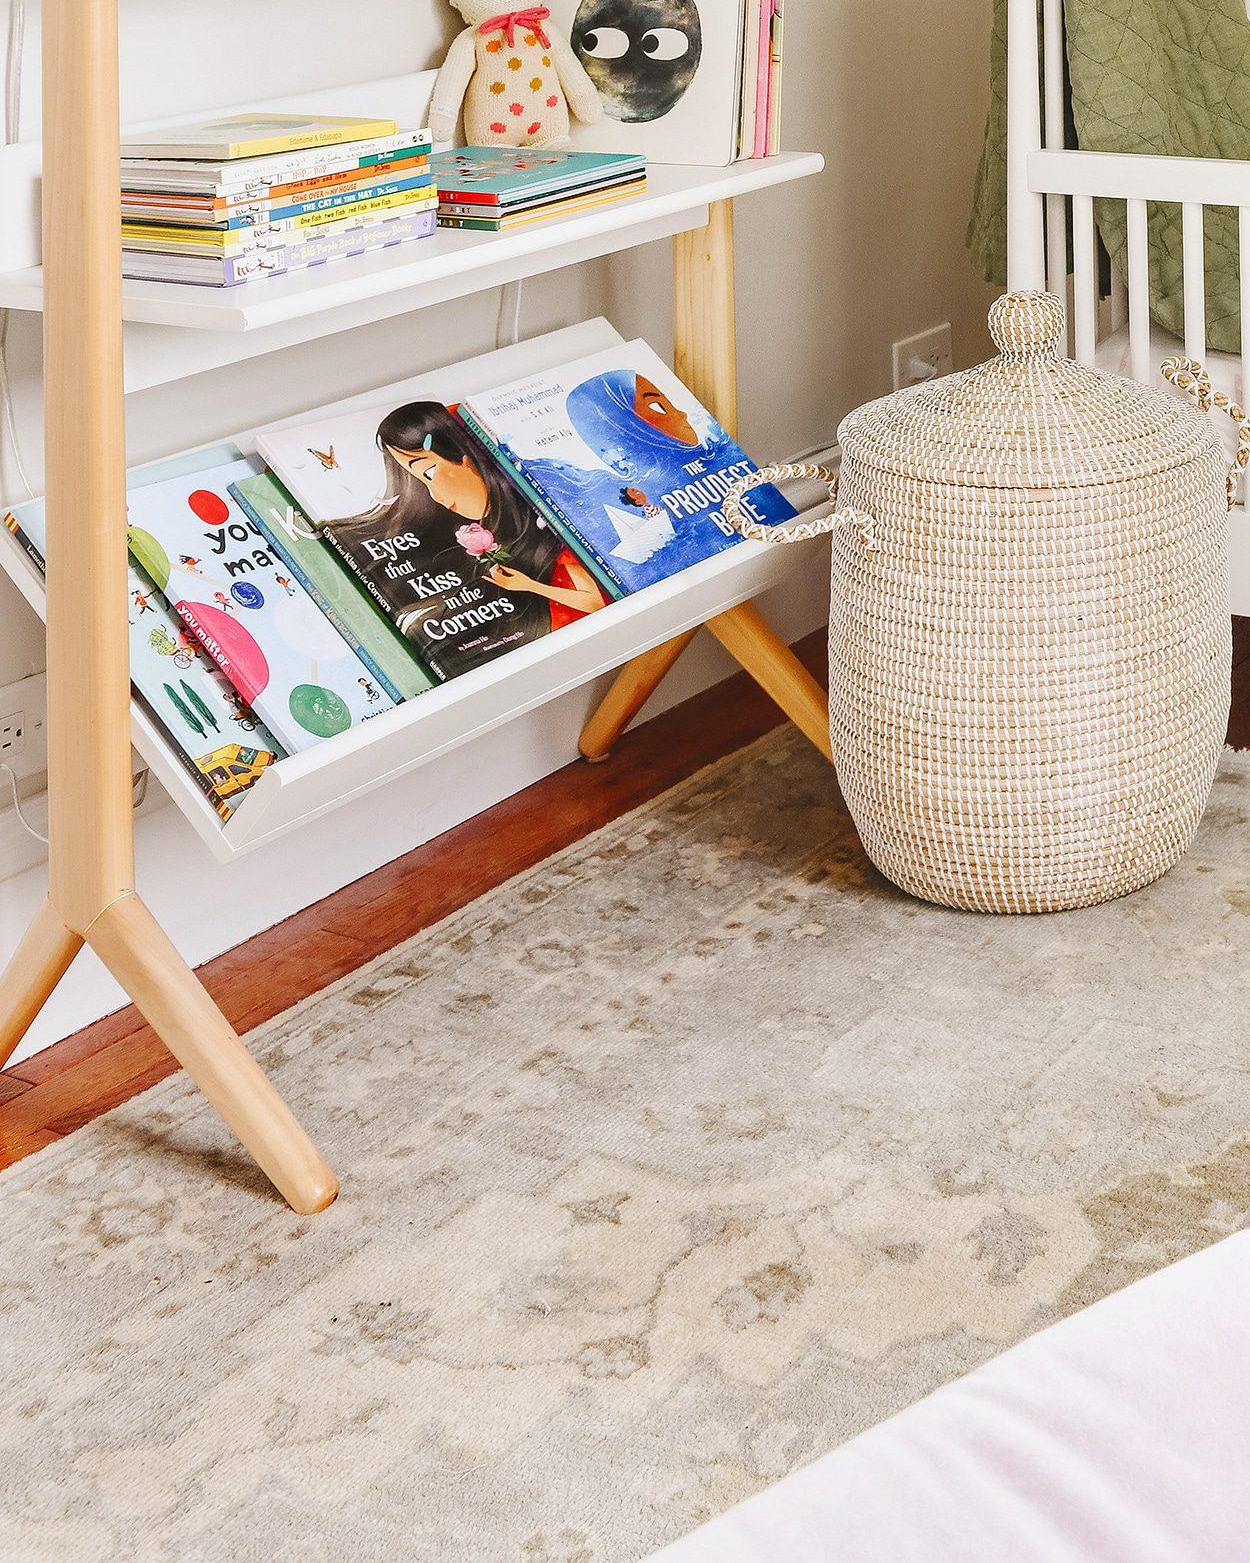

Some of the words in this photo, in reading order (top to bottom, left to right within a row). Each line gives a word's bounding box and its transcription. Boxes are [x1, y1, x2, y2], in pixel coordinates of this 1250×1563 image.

[292, 195, 307, 204] COME
[308, 191, 324, 200] OVER
[339, 183, 357, 193] HOUSE
[302, 202, 316, 212] THE
[318, 199, 333, 208] CAT
[334, 196, 342, 204] IN
[343, 194, 357, 202] THE
[358, 190, 374, 199] HAT
[300, 217, 310, 225] One
[312, 215, 322, 223] fish
[335, 209, 346, 218] fish
[348, 206, 357, 214] red
[357, 204, 367, 212] fish
[370, 201, 381, 209] blue
[300, 246, 317, 259] BIG
[391, 223, 413, 235] Books
[488, 401, 519, 417] Ibtihaj
[517, 383, 565, 407] Muhammad
[534, 434, 560, 447] Hatem
[681, 458, 708, 477] THE
[708, 496, 767, 537] BE
[361, 531, 421, 562] Eyes
[543, 495, 596, 555] PROUDEST
[594, 554, 623, 586] BLUE
[319, 525, 340, 547] Eyes
[341, 551, 360, 571] Kiss
[354, 567, 364, 577] in
[364, 580, 394, 613] Corners
[384, 559, 416, 580] that
[407, 570, 463, 600] Kiss
[441, 594, 459, 610] in
[458, 586, 484, 605] the
[422, 596, 515, 641] Corners
[175, 603, 199, 630] you
[194, 623, 231, 669] matter
